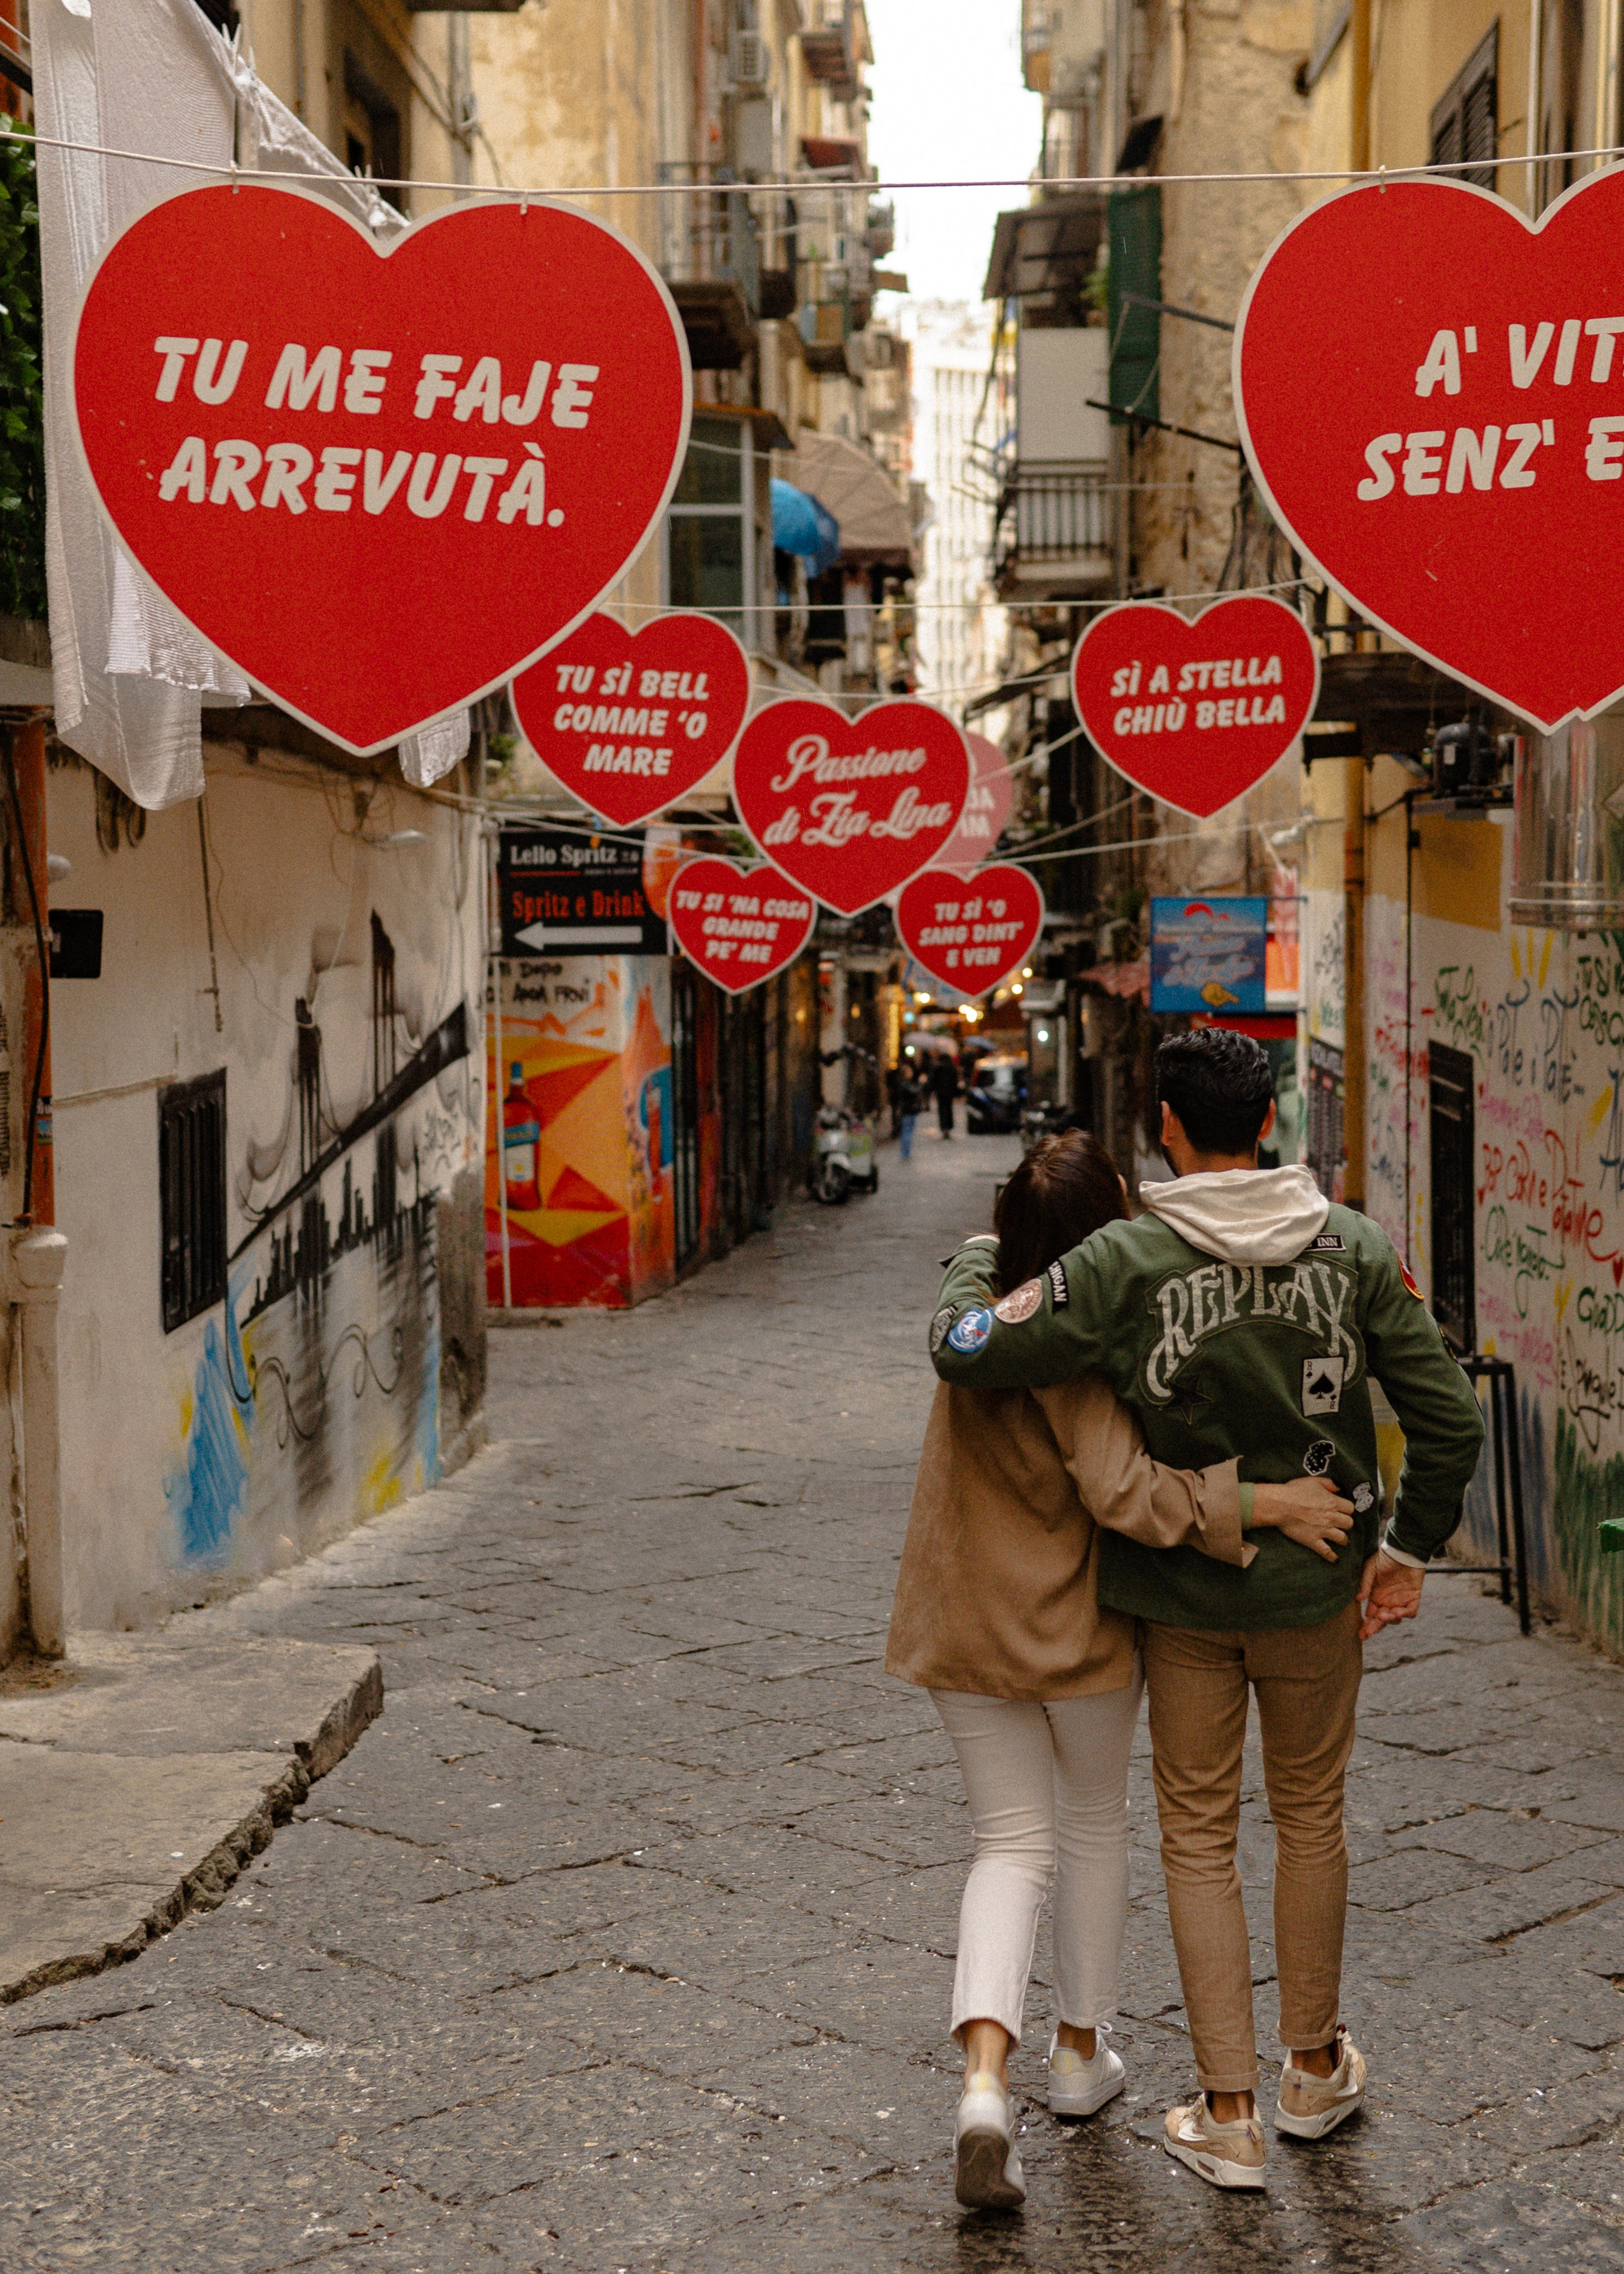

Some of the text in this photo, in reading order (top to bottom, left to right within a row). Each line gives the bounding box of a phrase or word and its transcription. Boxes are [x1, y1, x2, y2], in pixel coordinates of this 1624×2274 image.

[1415, 317, 1624, 397] A' VIT
[154, 336, 599, 428] TU ME FAJE
[1358, 419, 1554, 501] SENZ'
[159, 437, 564, 527] ARREVUTÀ.
[557, 662, 709, 700] TU SÌ BELL
[1111, 656, 1281, 697] SÌ A STELLA
[554, 704, 669, 736] COMME
[1113, 695, 1285, 735] CHIÙ BELLA
[584, 744, 672, 776] MARE
[771, 734, 926, 792] Passione
[763, 806, 801, 845] di
[869, 786, 952, 839] Lina
[510, 845, 557, 865] Lello
[561, 845, 617, 867] Spritz
[512, 890, 645, 923] Spritz e Drink
[677, 890, 702, 909] TU
[763, 899, 809, 919] COSA
[935, 902, 959, 921] TU
[702, 916, 779, 941] GRANDE
[919, 926, 967, 946] SANG
[740, 943, 771, 963] ME
[946, 947, 1000, 967] E VEN
[1317, 1237, 1338, 1247] INN
[1146, 1260, 1358, 1397] REPLAY
[1307, 1360, 1313, 1370] R
